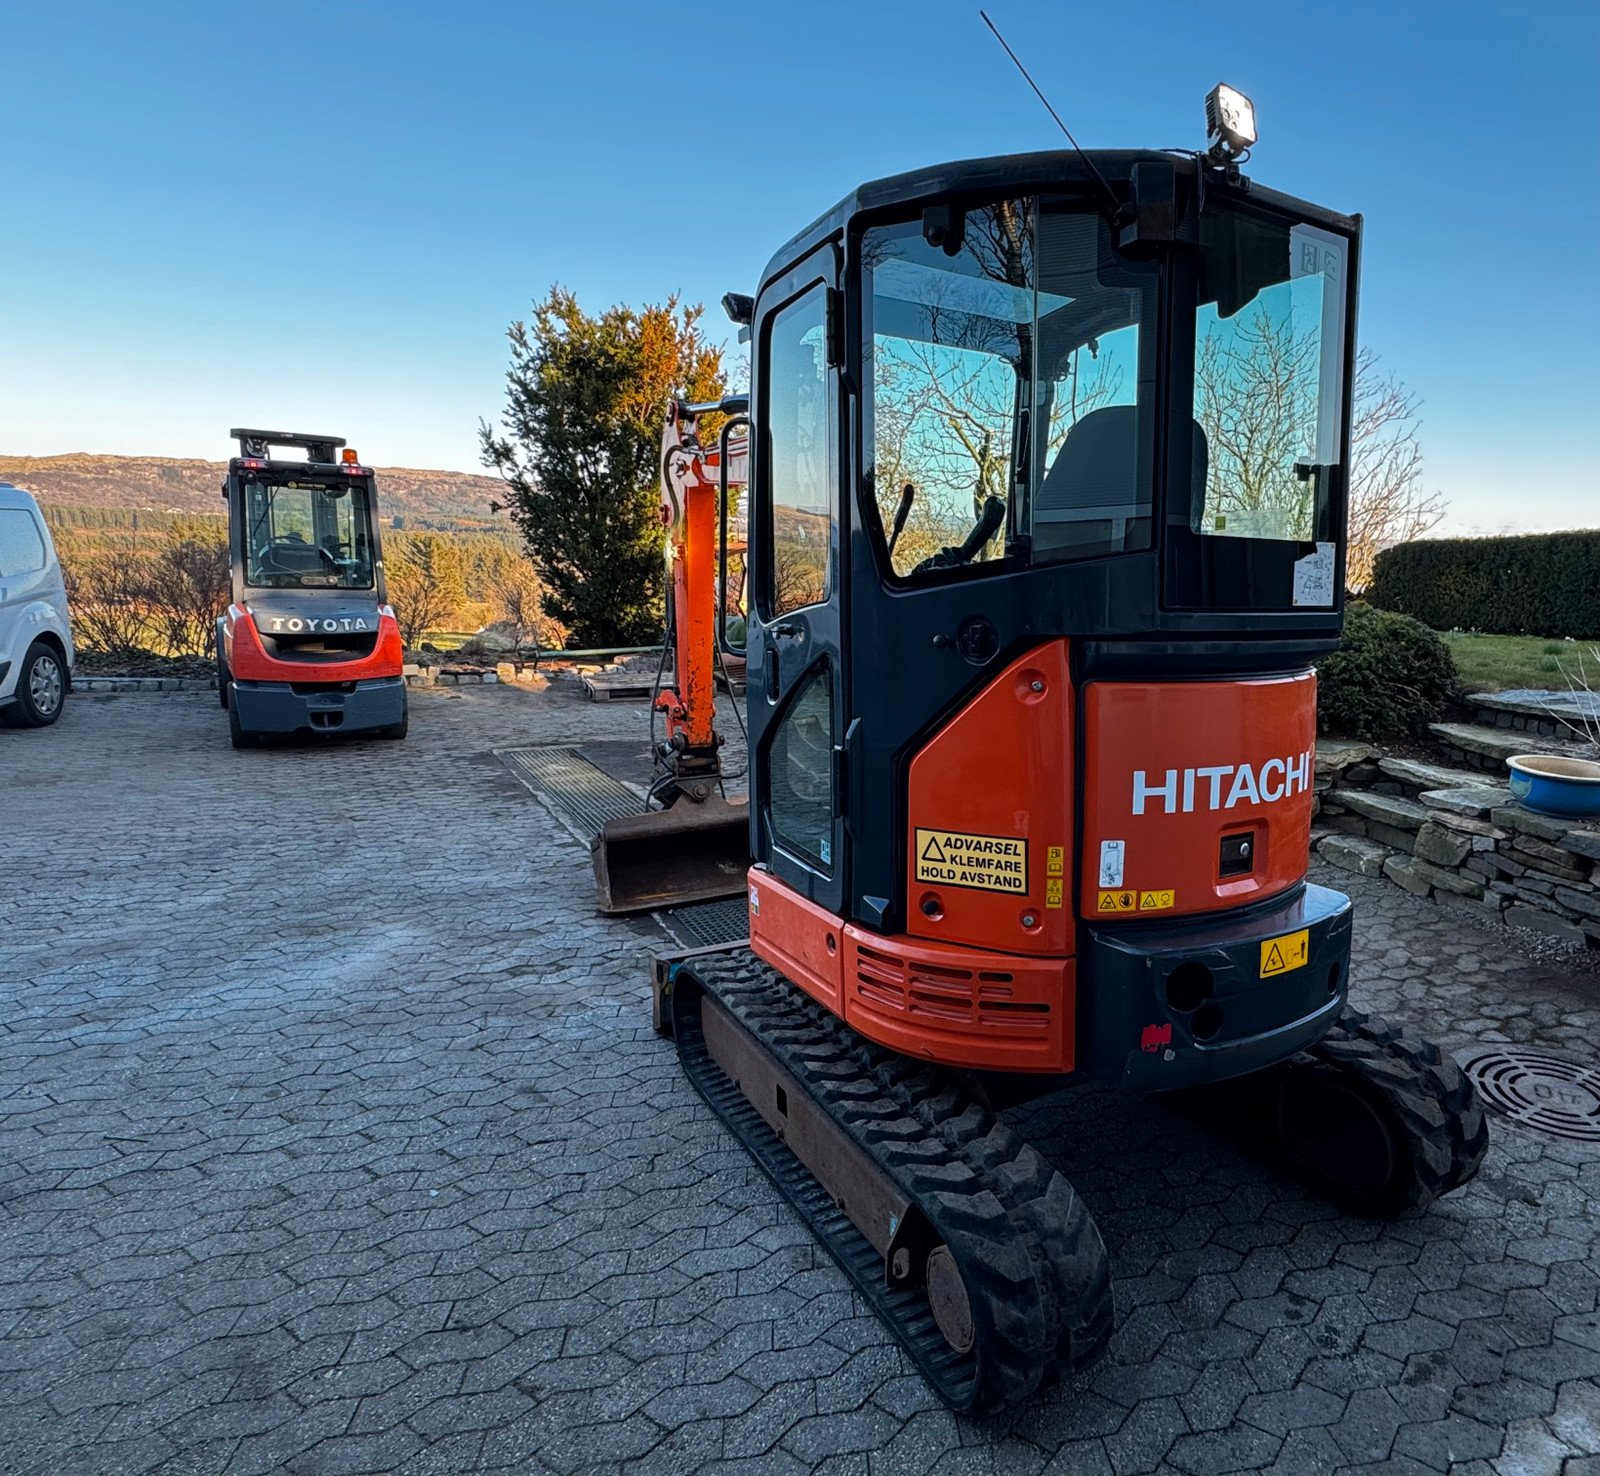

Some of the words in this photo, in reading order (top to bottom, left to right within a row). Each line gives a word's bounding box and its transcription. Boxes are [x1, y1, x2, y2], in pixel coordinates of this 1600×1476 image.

[272, 617, 368, 632] TOYOTA
[1132, 751, 1310, 815] HITACHI
[943, 837, 1022, 856] ADVARSEL
[950, 854, 1022, 873] KLEMFARE
[921, 866, 956, 879] HOLD
[960, 871, 1022, 888] AVSTAND
